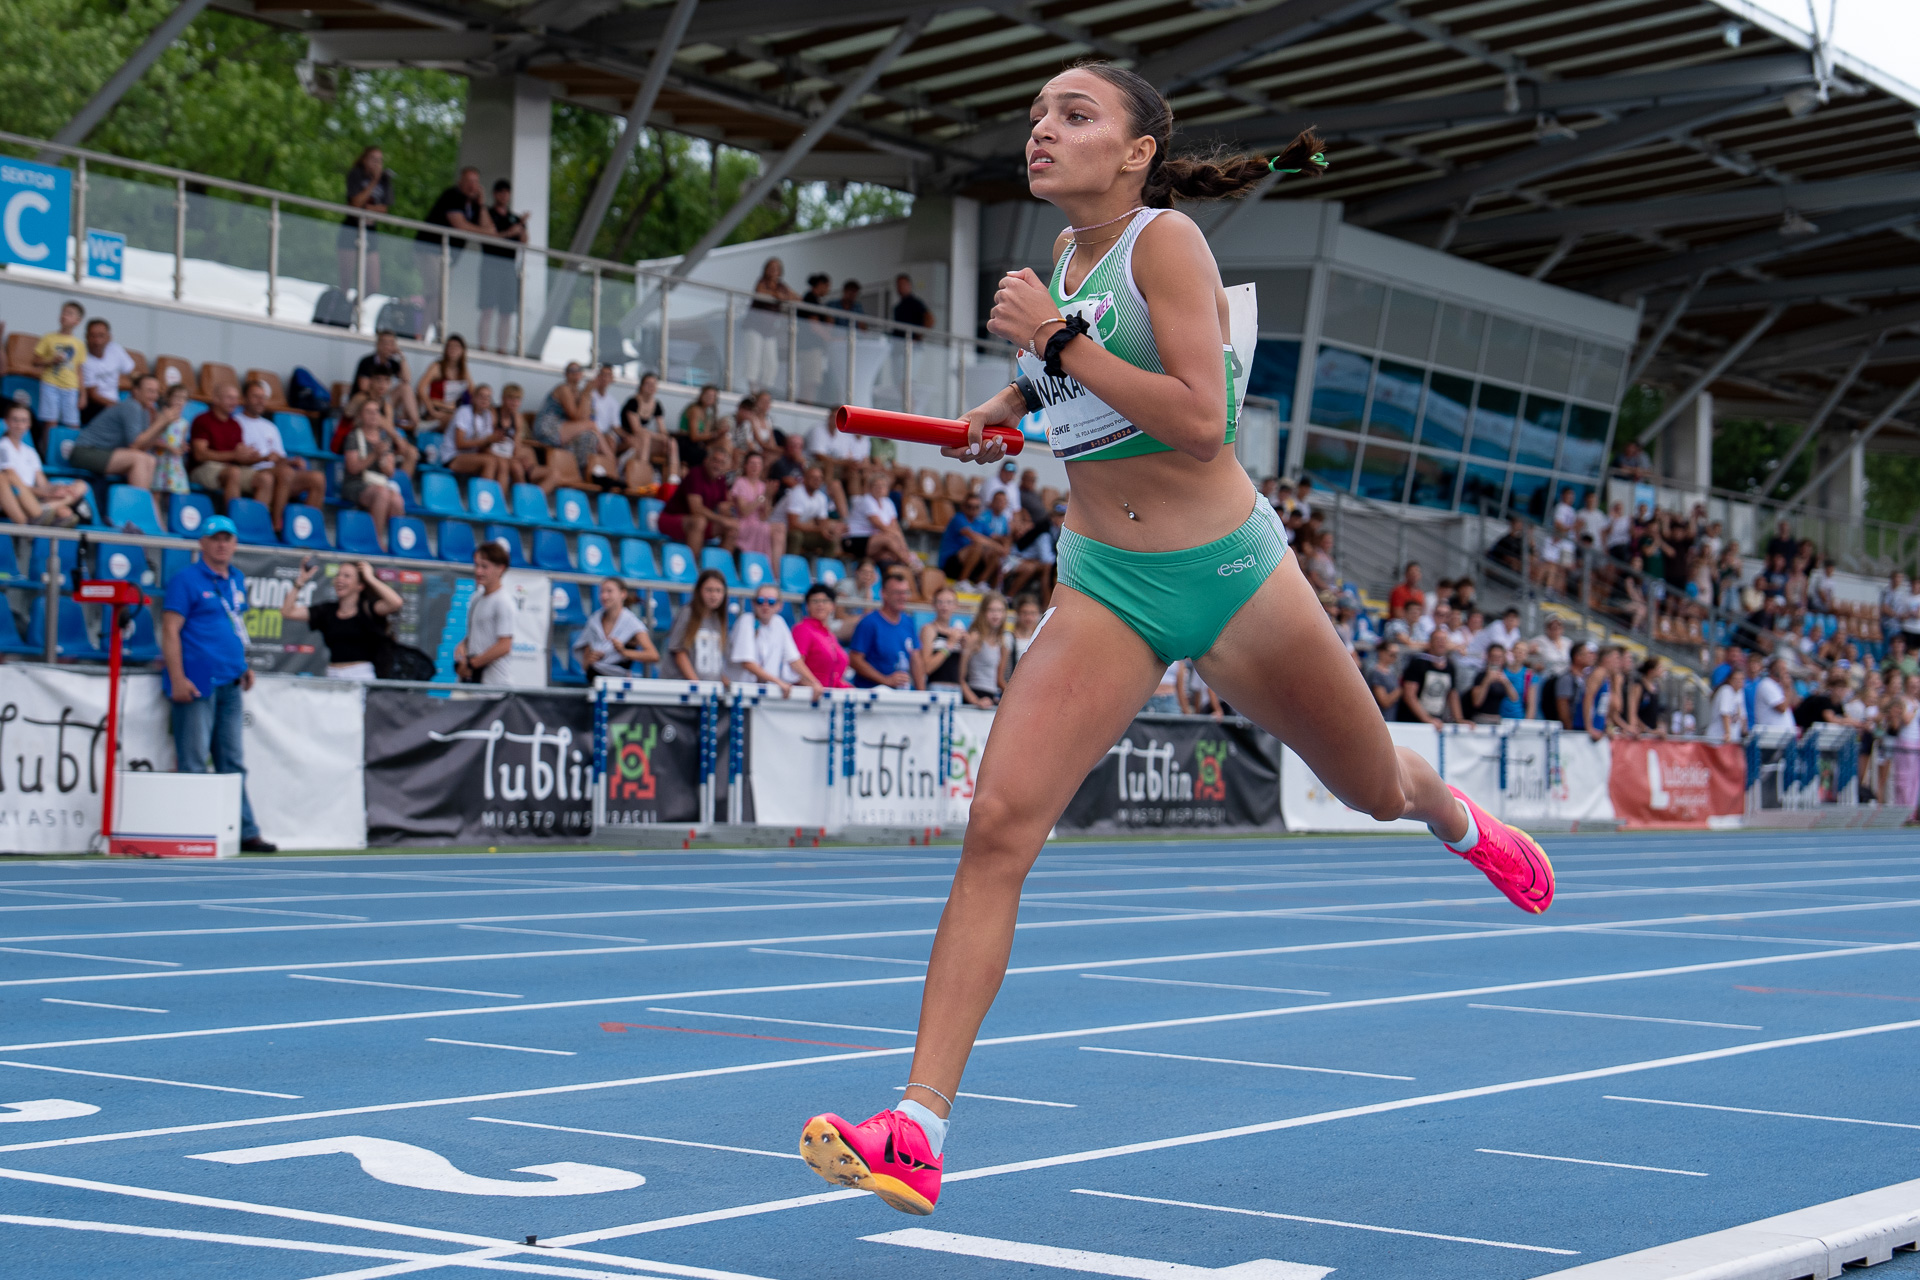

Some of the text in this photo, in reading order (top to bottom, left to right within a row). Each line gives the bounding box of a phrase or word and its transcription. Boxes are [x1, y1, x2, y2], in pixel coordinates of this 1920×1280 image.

[1, 164, 55, 190] SEKTOR
[3, 189, 51, 262] C
[88, 235, 122, 264] WC
[1217, 554, 1258, 577] esa
[244, 608, 283, 639] am
[1109, 737, 1193, 801] Lublin
[480, 810, 556, 828] MIASTO
[185, 1135, 646, 1197] 2
